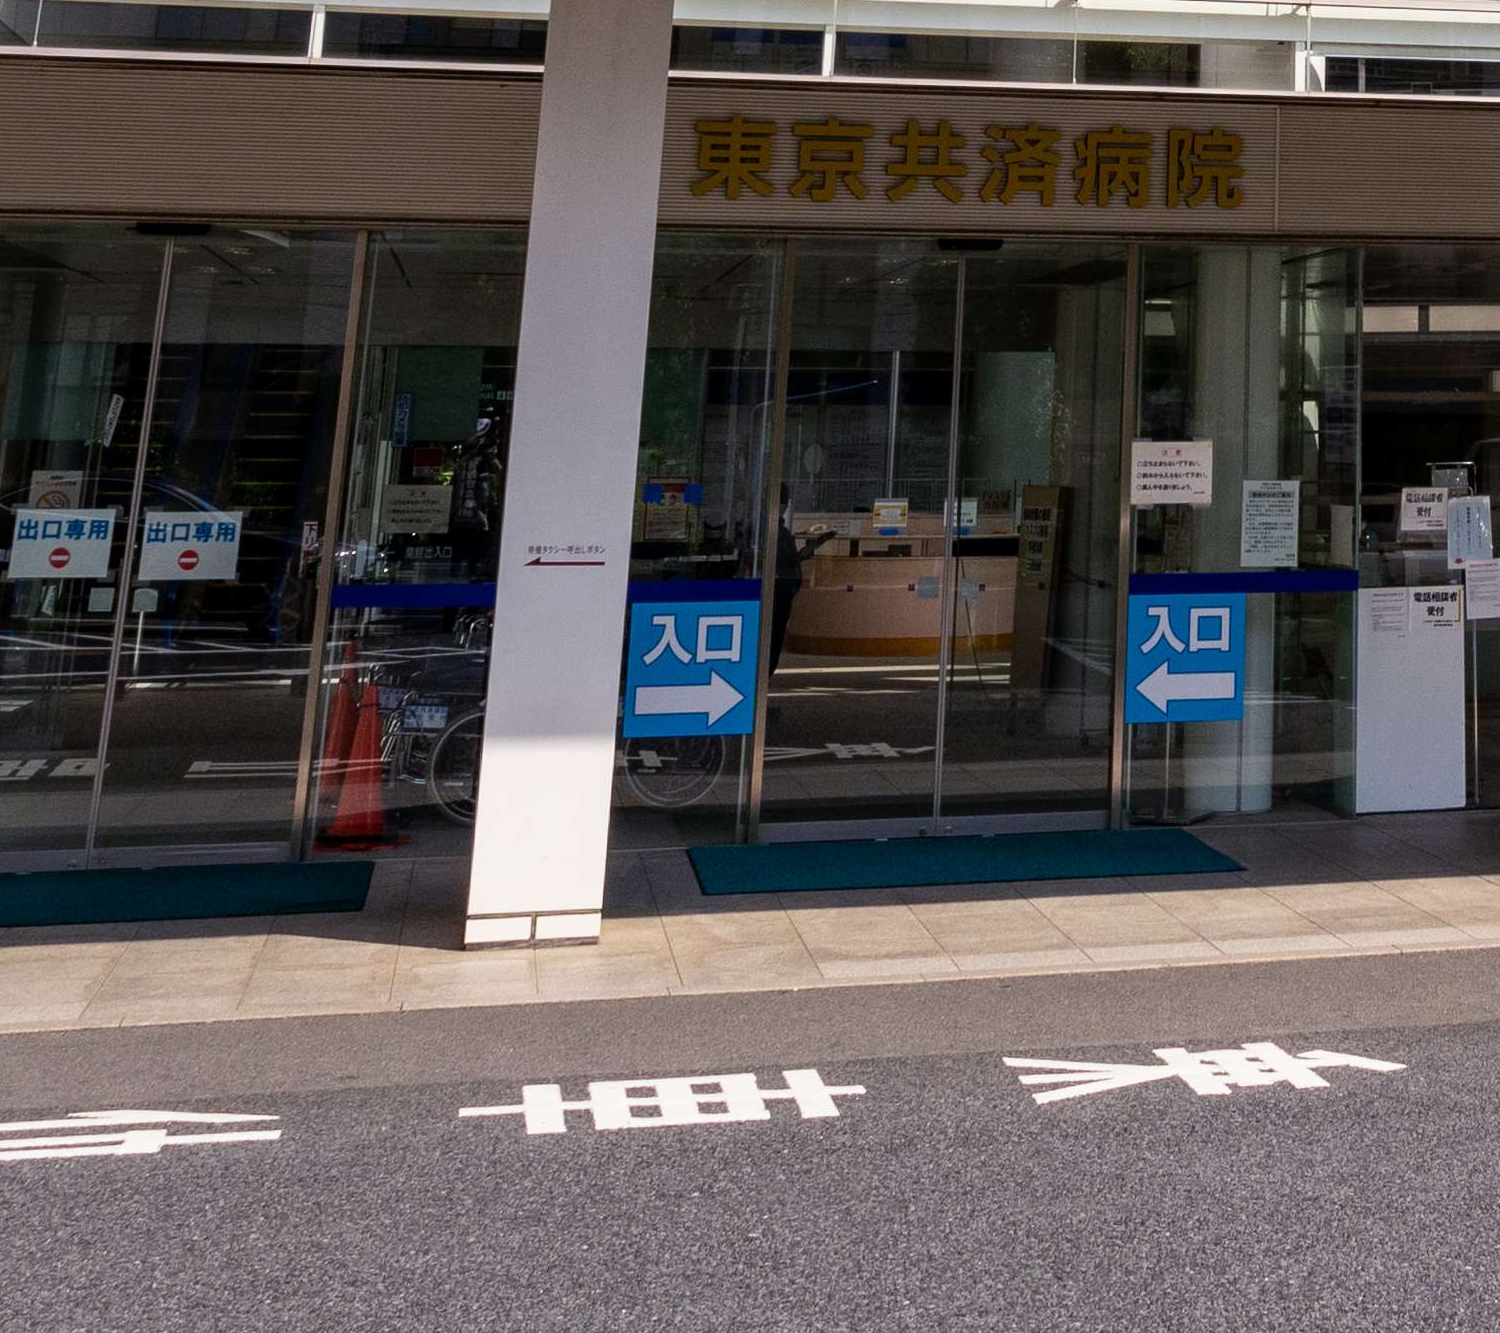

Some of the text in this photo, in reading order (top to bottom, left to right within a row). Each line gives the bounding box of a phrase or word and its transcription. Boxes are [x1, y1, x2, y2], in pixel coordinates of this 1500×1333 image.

[691, 115, 1245, 209] 東京共済病院
[16, 519, 110, 541] 出口専用
[146, 521, 237, 544] 出口専用
[1413, 591, 1458, 603] 電話相談者
[1426, 606, 1445, 617] 受付
[642, 614, 744, 666] 入口
[1140, 606, 1231, 654] 入口
